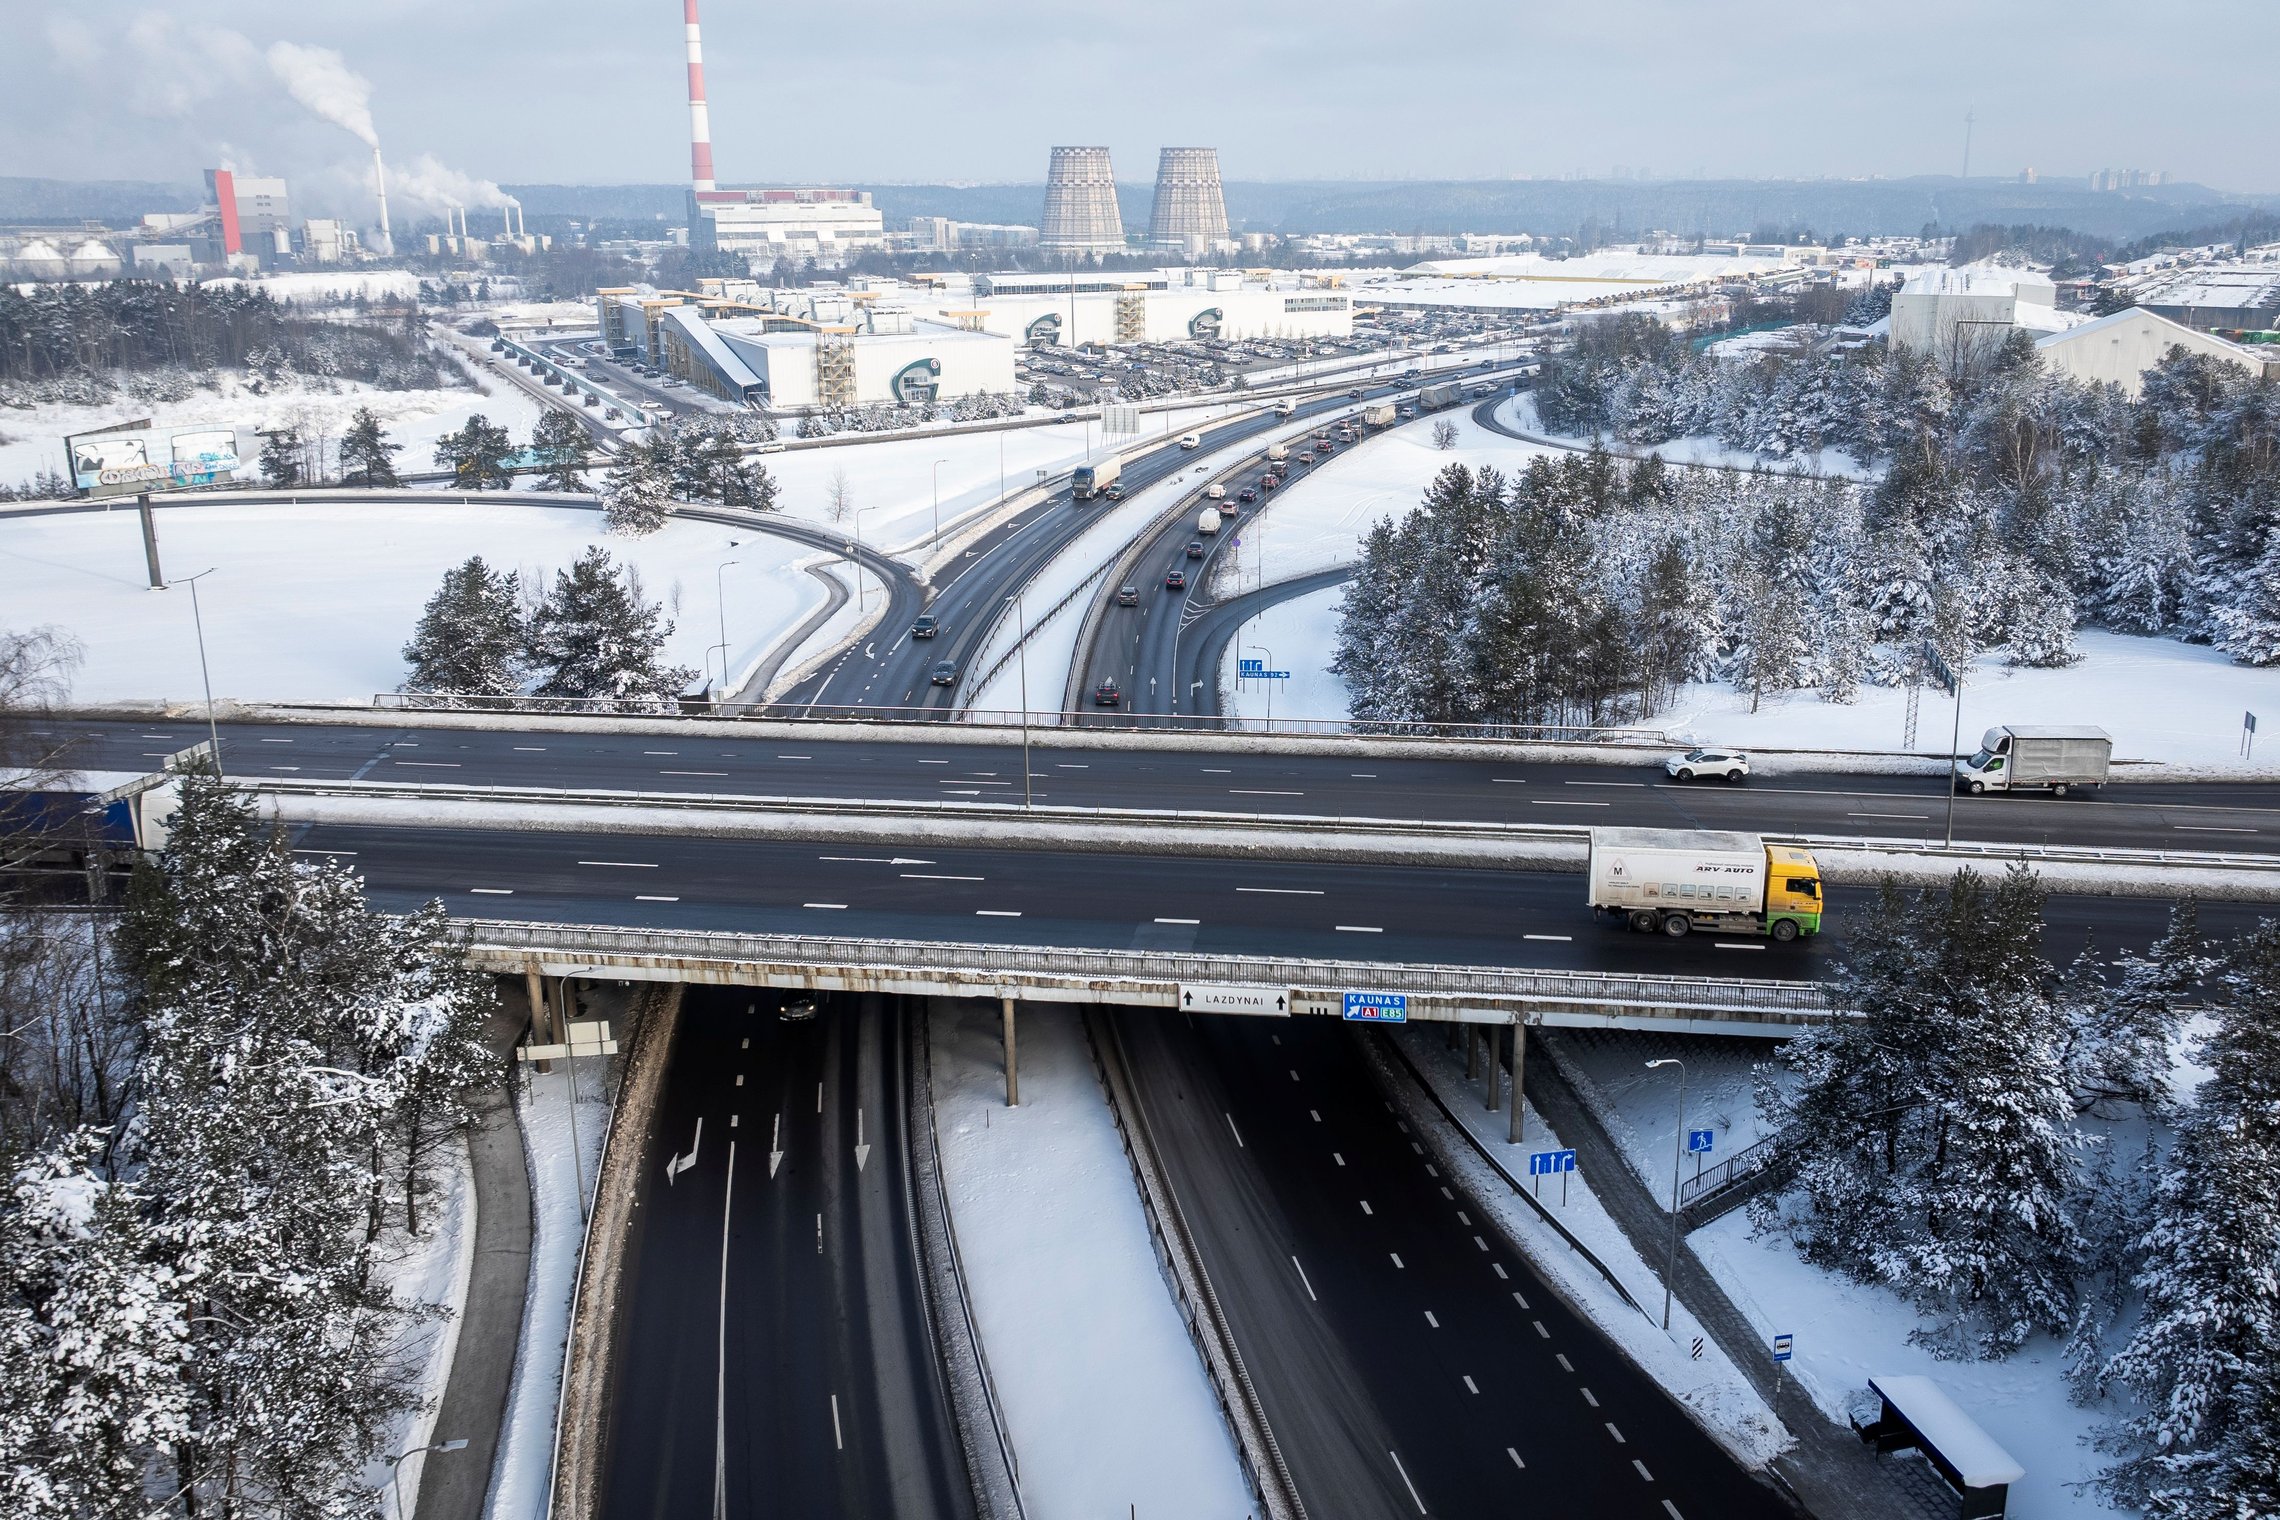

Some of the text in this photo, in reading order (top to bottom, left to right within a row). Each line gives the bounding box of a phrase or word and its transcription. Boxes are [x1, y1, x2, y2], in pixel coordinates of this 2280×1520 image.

[1613, 867, 1623, 876] M
[1205, 994, 1264, 1006] LAZDYNAI
[1349, 994, 1401, 1006] KAUNAS
[1363, 1008, 1378, 1018] A1
[1382, 1009, 1402, 1018] E85
